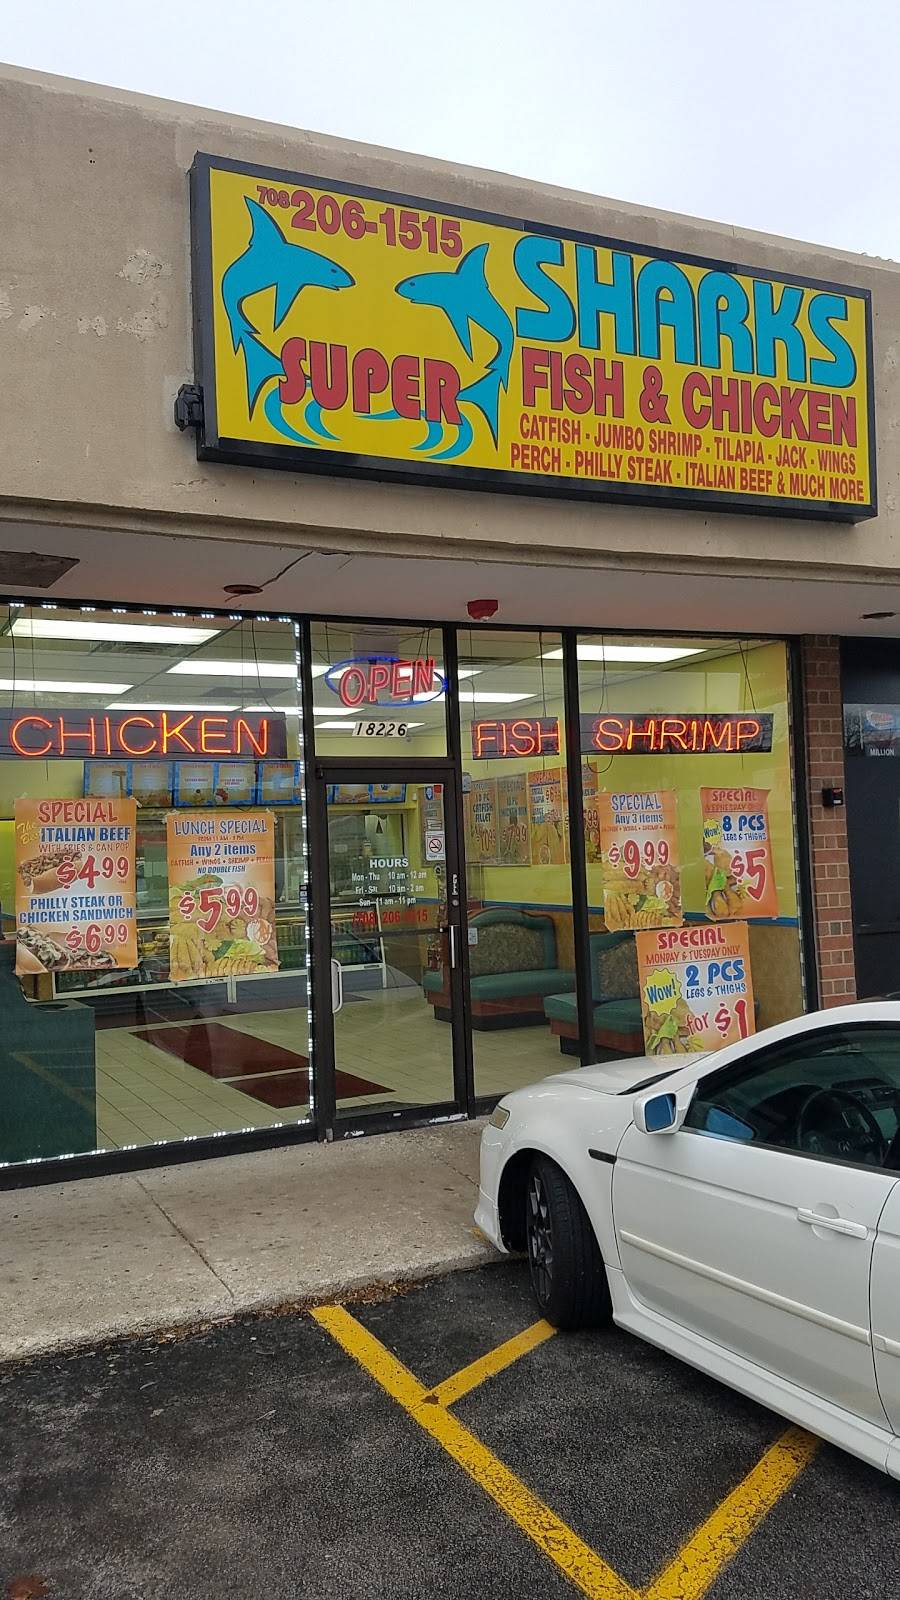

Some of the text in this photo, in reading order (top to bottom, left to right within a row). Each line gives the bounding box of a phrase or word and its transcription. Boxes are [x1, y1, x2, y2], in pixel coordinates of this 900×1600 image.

[256, 186, 463, 258] 708 206-1515
[513, 234, 857, 388] SHARKS
[279, 337, 463, 425] SUPER
[522, 346, 857, 448] FISH & CHICKEN
[519, 412, 856, 476] CATFISH JUMBO SHRIMP TILAPIA JACK WINGS
[510, 442, 864, 501] PERCH PHILLY STEAK ITALIAN BEEF & MUCH MORE
[339, 655, 436, 708] OPEN
[10, 711, 269, 757] CHICKEN
[356, 722, 408, 737] 18226
[476, 719, 562, 757] FISH
[595, 717, 761, 752] SHRIMP
[870, 748, 895, 757] MILLION
[612, 793, 662, 811] SPECIAL
[711, 789, 757, 802] SPECIAL
[38, 801, 119, 824] SPECIAL
[615, 813, 664, 825] Any 3 items
[174, 819, 267, 836] LUNCH SPECIAL
[722, 814, 766, 832] 8 PCS
[41, 826, 131, 843] ITALIAN BEEF
[723, 833, 737, 841] LEGS
[743, 832, 767, 841] THIGHS
[96, 843, 113, 852] CAN
[115, 843, 130, 852] POP
[190, 843, 256, 857] Any 2 items
[197, 865, 246, 874] NO DOUBLE FISH
[369, 858, 409, 869] HOURS
[351, 872, 364, 882] Mon
[368, 872, 380, 881] Thu
[388, 871, 396, 880] 10
[410, 870, 417, 879] 12
[730, 847, 767, 902] $5
[355, 886, 364, 895] Fri
[389, 884, 396, 893] 10
[397, 885, 406, 893] am
[30, 895, 123, 910] PHILLY STEAK OR
[359, 898, 371, 907] Sun
[19, 908, 133, 924] CHICKEN SANDWICH
[658, 926, 726, 950] SPECIAL
[646, 951, 680, 965] MONDAY
[689, 947, 721, 960] TUESDAY
[722, 945, 741, 956] ONLY
[685, 959, 745, 987] 2 PCS
[646, 978, 677, 1005] Wow!
[686, 987, 705, 1000] LEGS
[715, 982, 747, 996] THIGHS
[686, 999, 749, 1039] for $1
